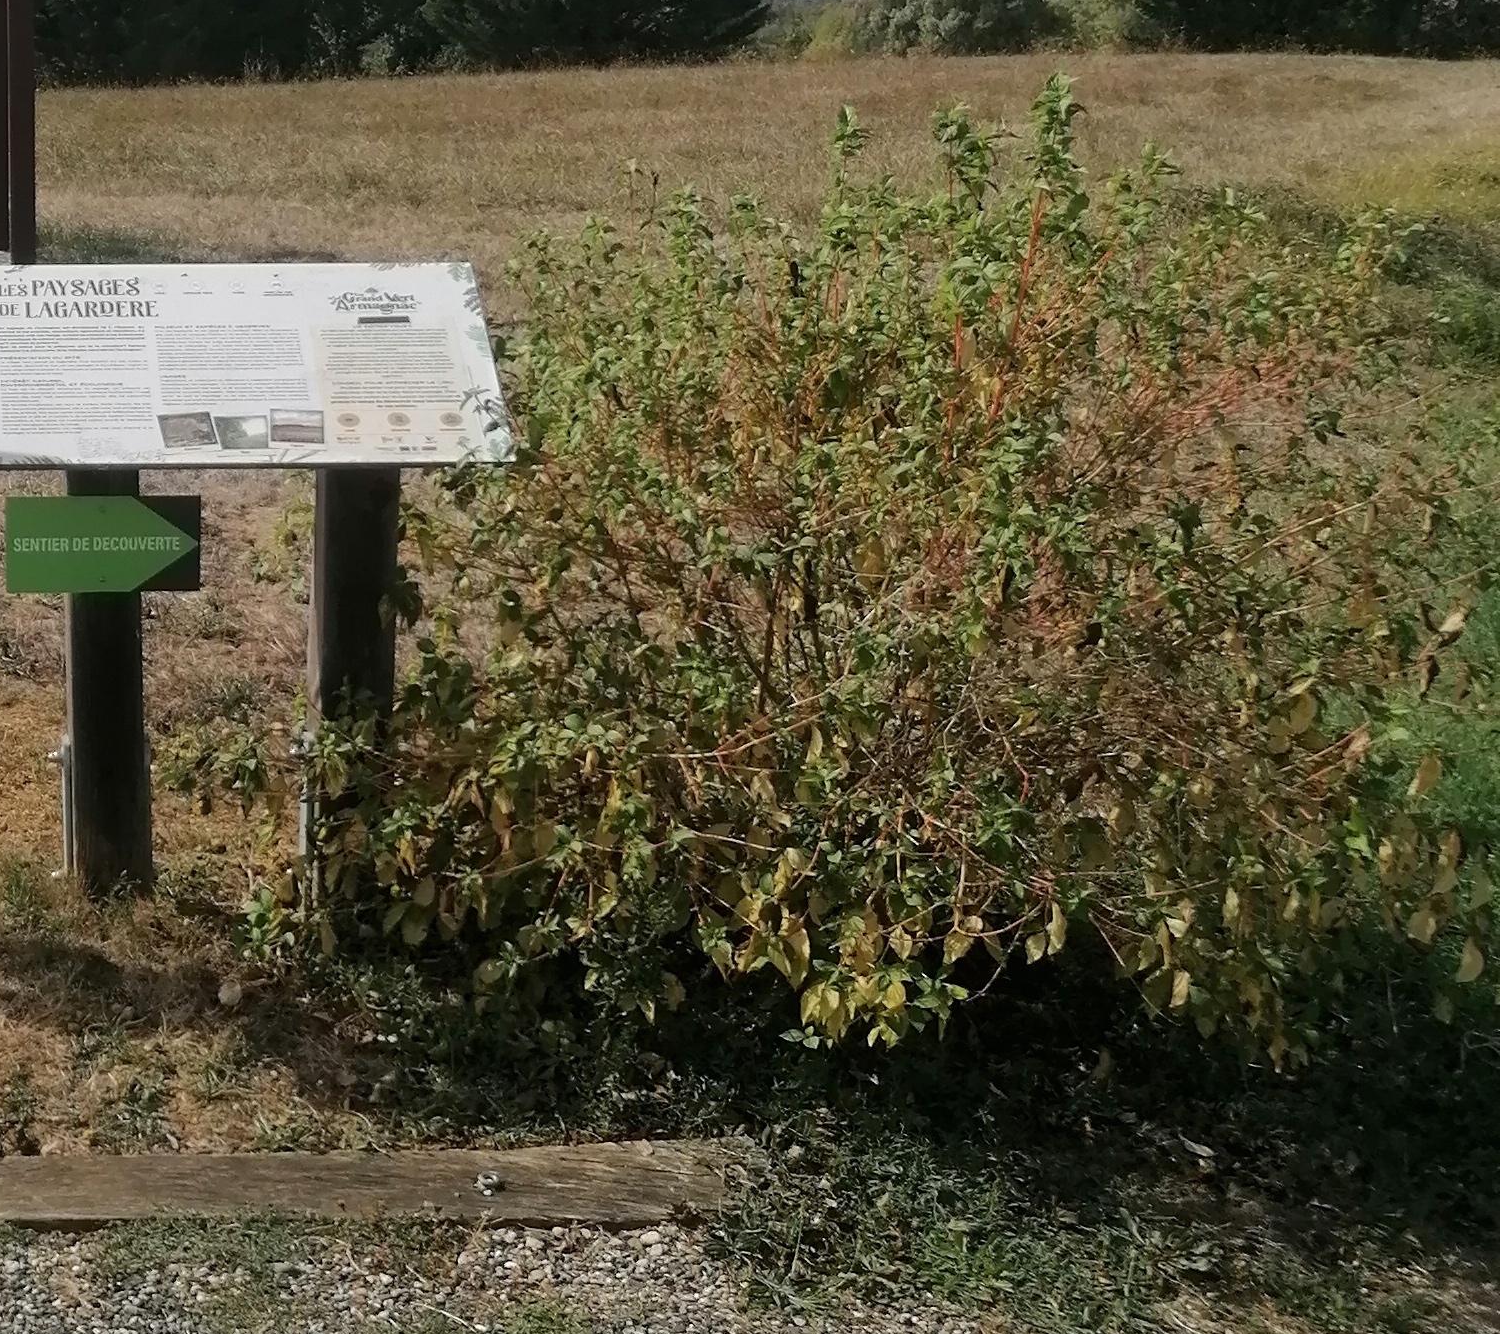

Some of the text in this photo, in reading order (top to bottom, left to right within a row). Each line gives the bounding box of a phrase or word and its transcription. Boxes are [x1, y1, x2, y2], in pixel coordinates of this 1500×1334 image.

[32, 277, 140, 297] PAYSAGES
[25, 300, 159, 318] LAGARDERE
[13, 536, 180, 552] SENTIER DE DECOUVERTE
